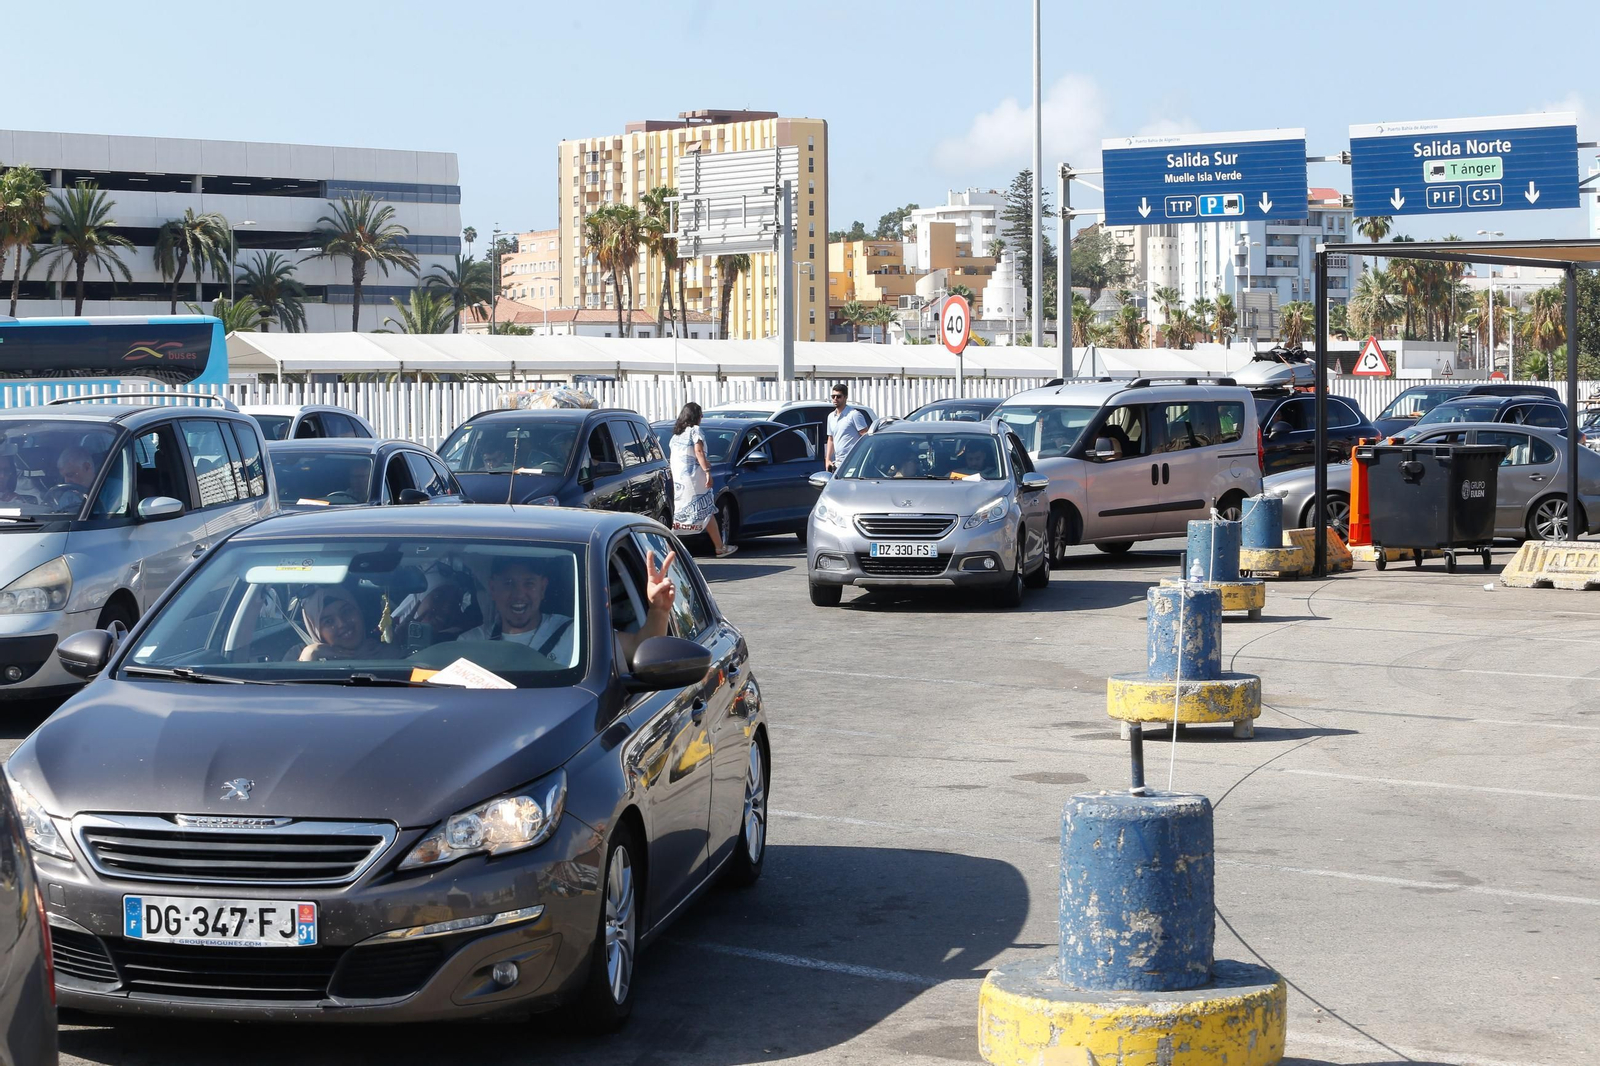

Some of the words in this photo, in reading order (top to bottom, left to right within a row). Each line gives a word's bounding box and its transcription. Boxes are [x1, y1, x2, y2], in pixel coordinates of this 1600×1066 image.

[1413, 140, 1461, 157] Salida
[1466, 139, 1512, 154] Norte
[1166, 151, 1210, 168] Salida
[1214, 151, 1238, 166] Sur
[1164, 172, 1195, 183] Muelle
[1197, 171, 1213, 182] Isla
[1215, 170, 1242, 181] Verde
[1433, 191, 1455, 203] PIF
[1472, 189, 1496, 201] CSI
[1170, 200, 1192, 212] TTP
[1207, 197, 1217, 214] P
[946, 315, 963, 334] 40
[130, 920, 136, 929] F
[145, 904, 296, 939] DG-347-FJ
[299, 924, 314, 940] 31
[178, 938, 262, 948] GROUPEMOUNES.COM
